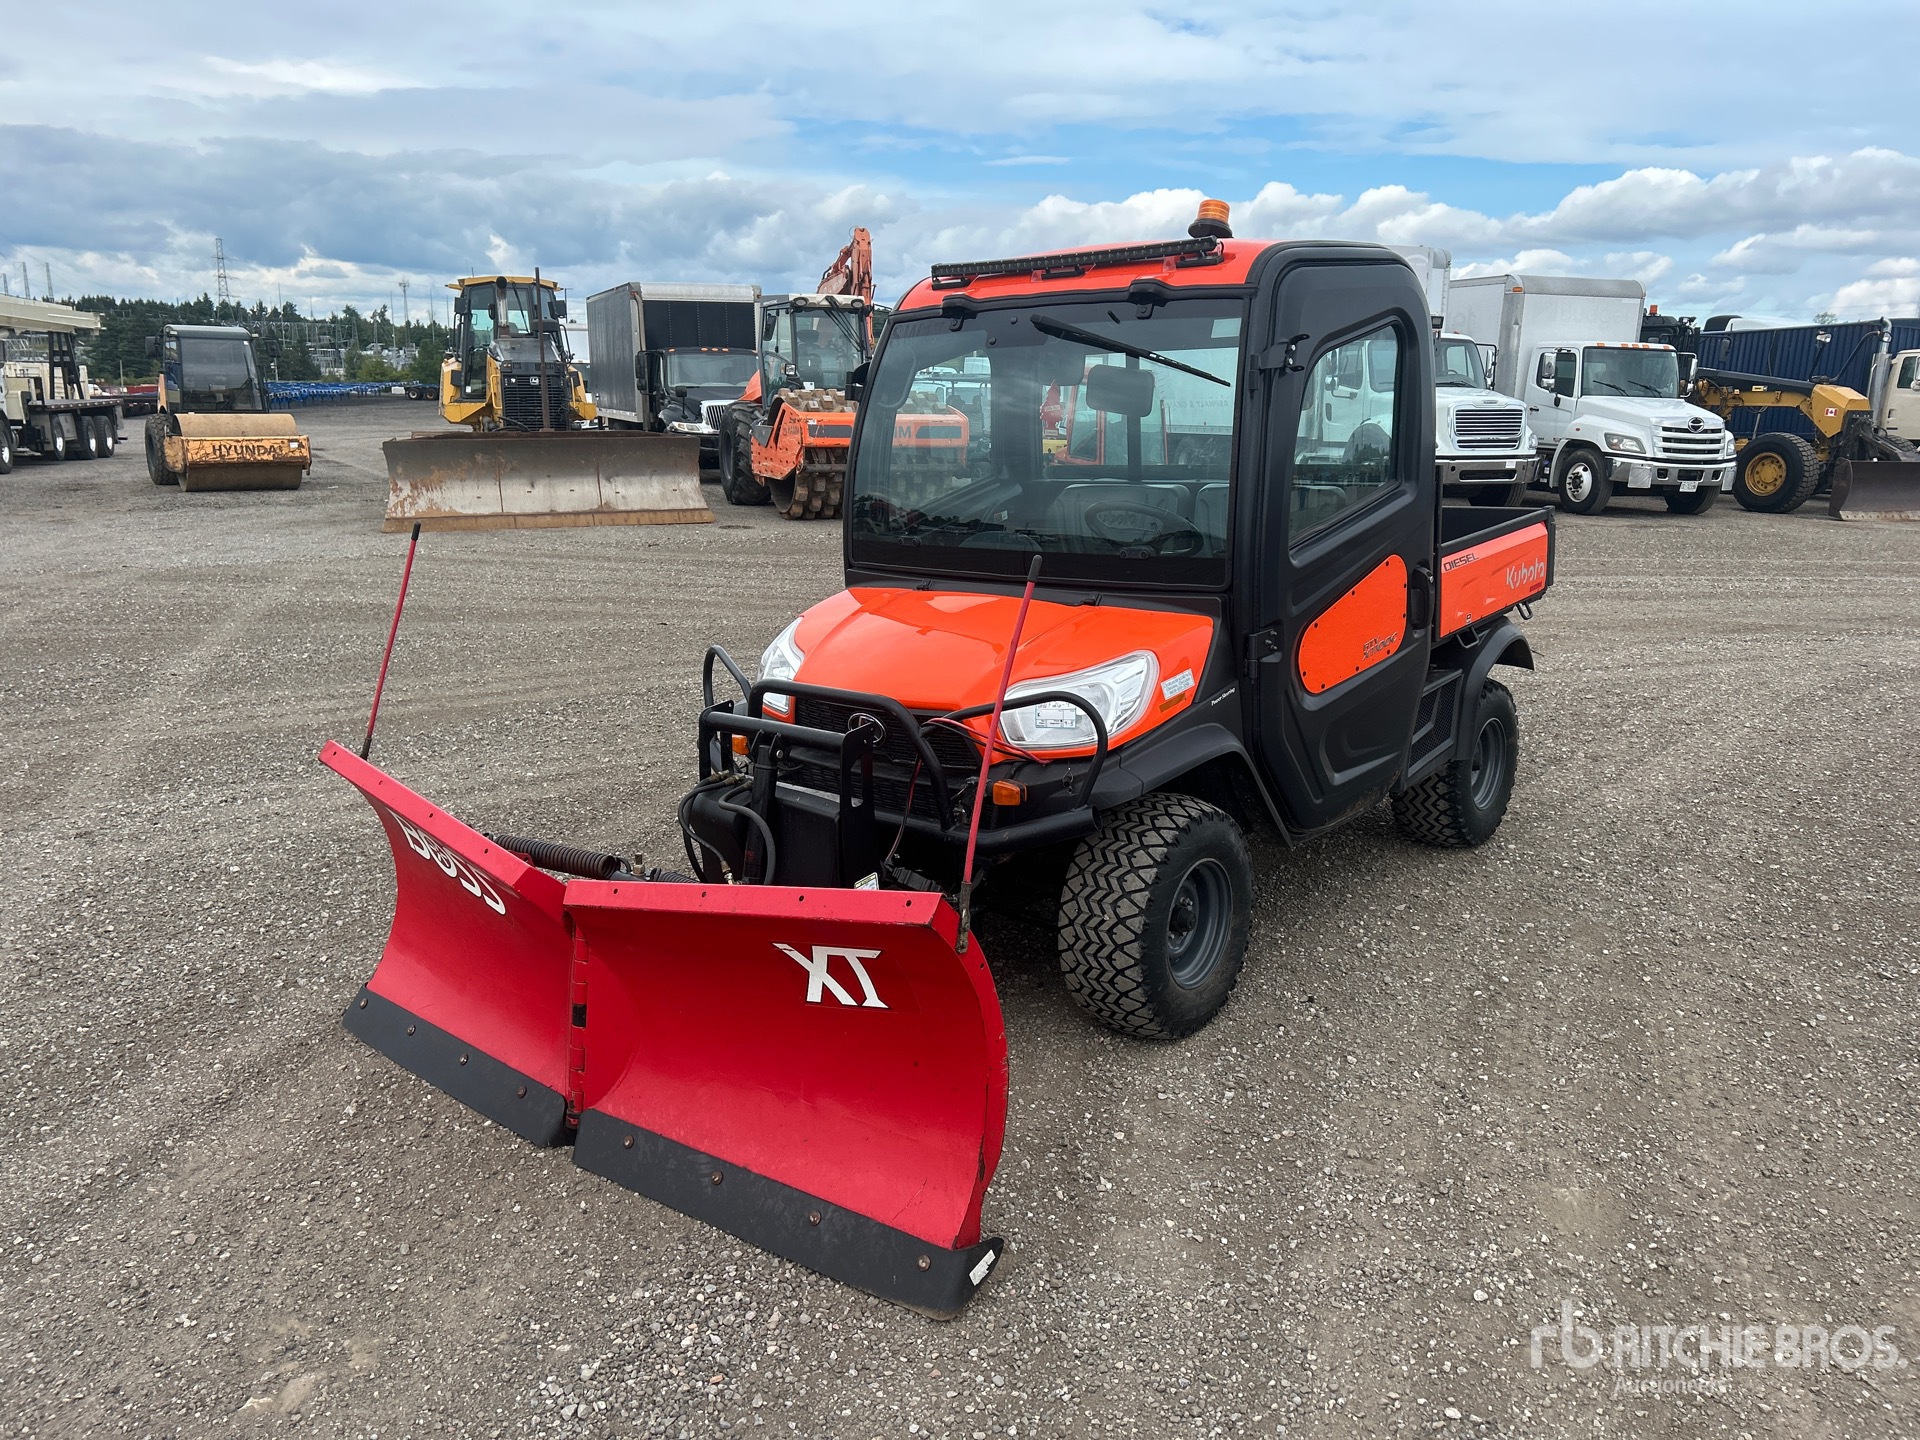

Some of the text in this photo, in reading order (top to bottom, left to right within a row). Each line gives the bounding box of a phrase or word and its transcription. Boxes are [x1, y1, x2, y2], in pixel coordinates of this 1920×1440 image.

[1443, 553, 1480, 572] DIESEL
[1506, 558, 1545, 589] Kubota
[386, 808, 506, 915] BOSS
[772, 942, 889, 1009] XT
